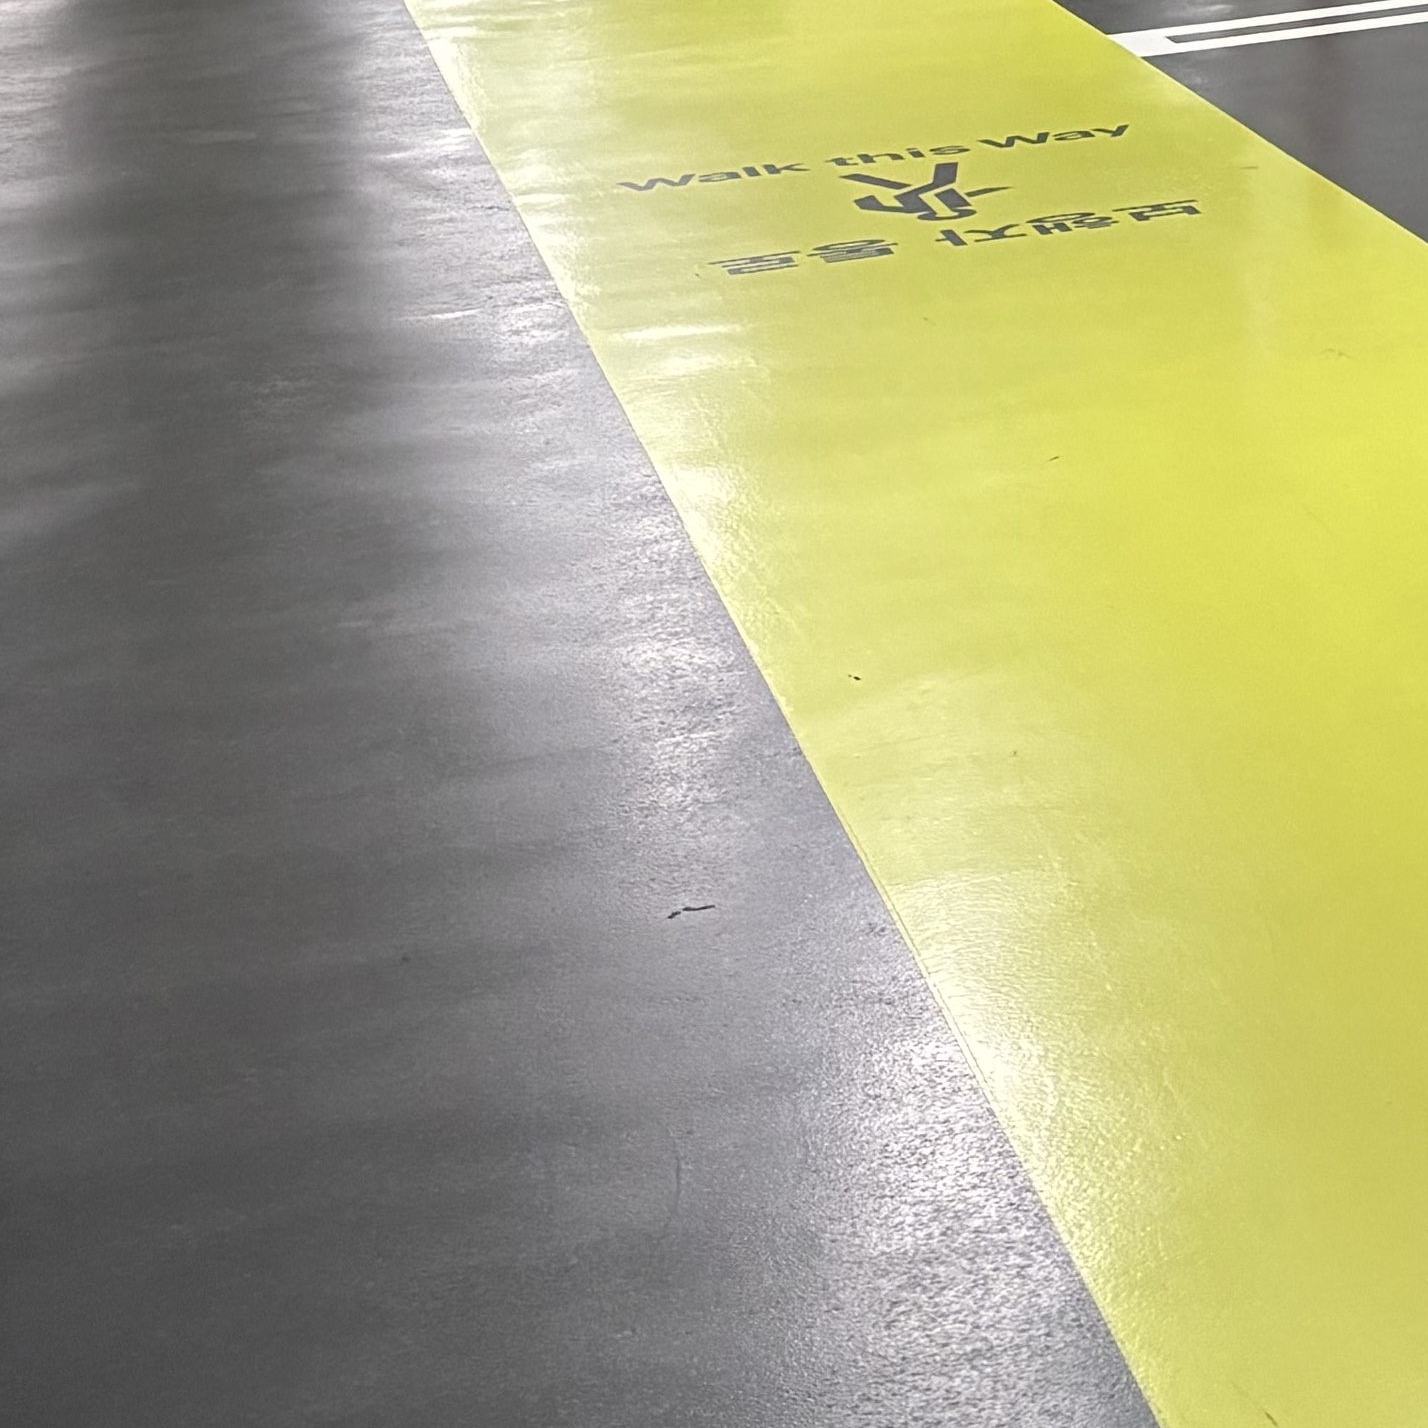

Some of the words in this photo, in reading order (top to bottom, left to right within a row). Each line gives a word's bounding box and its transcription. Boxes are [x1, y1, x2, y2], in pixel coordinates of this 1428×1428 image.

[617, 162, 811, 192] Walk
[825, 144, 971, 167] this
[978, 123, 1130, 150] Way
[935, 199, 1202, 247] 보행자
[708, 238, 899, 276] 통로
